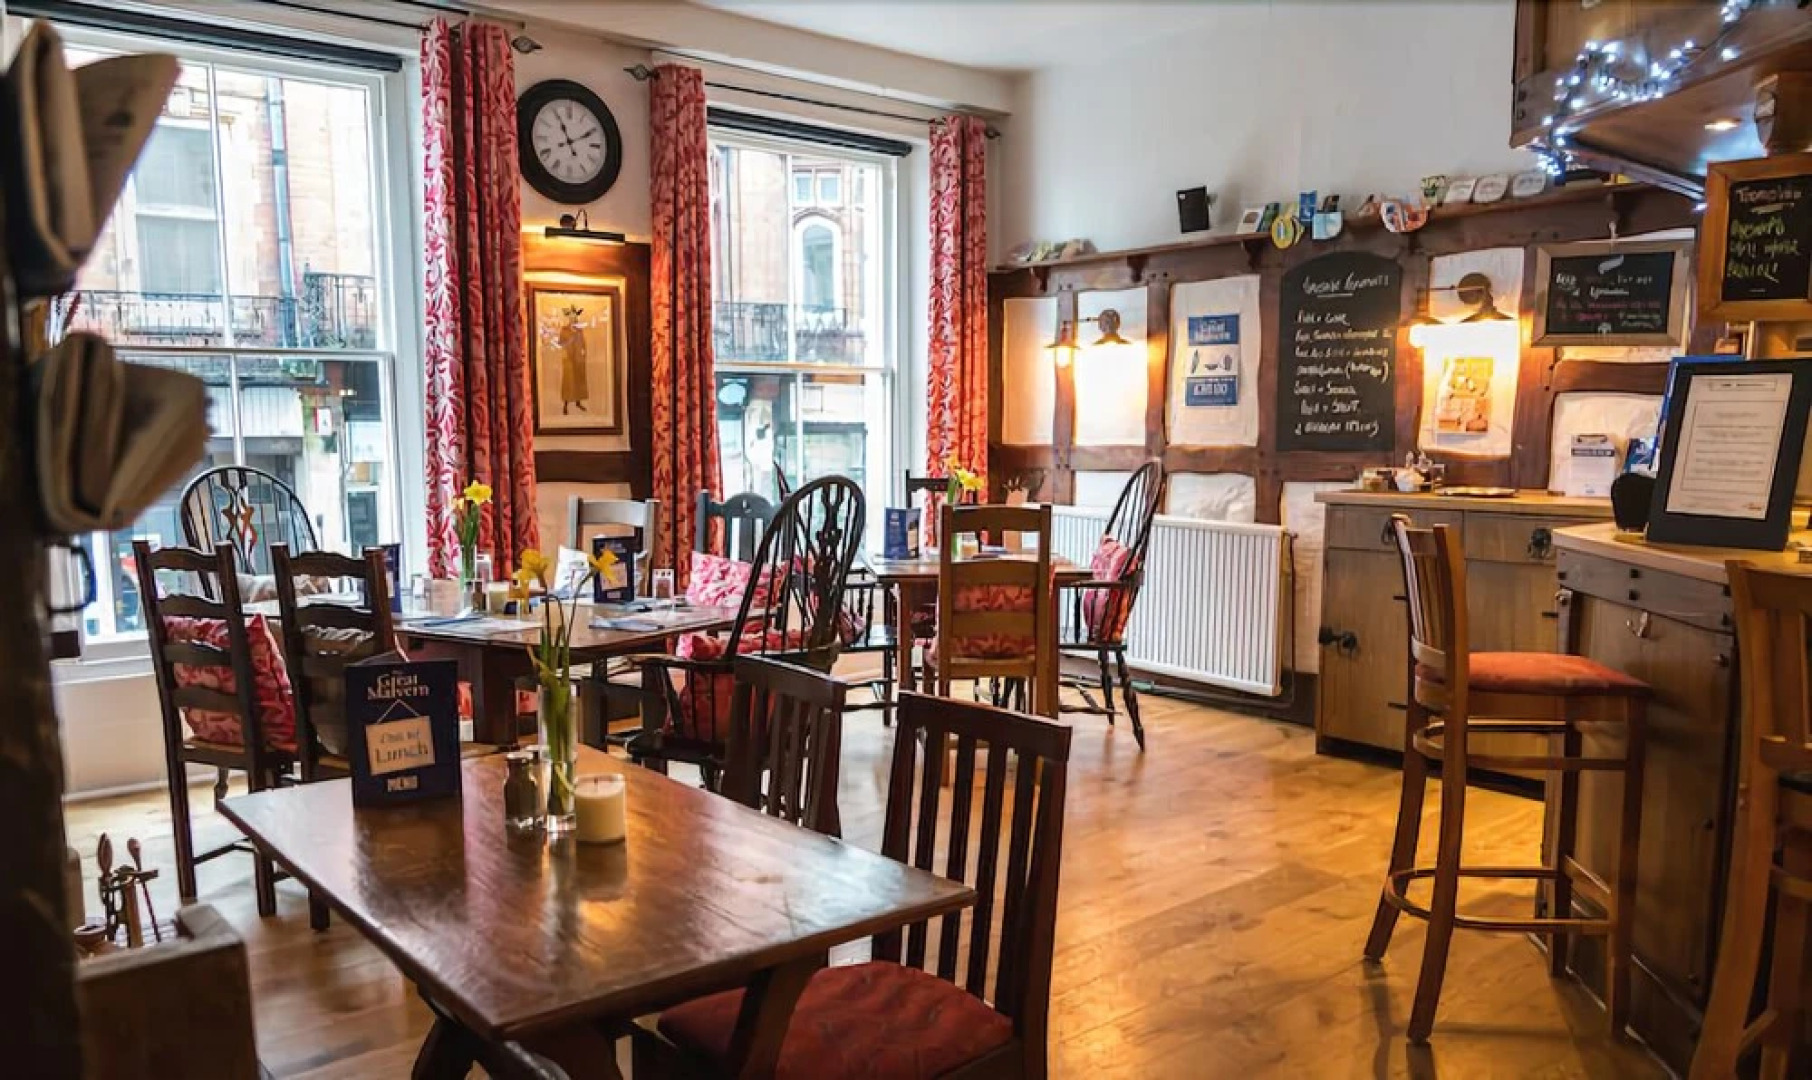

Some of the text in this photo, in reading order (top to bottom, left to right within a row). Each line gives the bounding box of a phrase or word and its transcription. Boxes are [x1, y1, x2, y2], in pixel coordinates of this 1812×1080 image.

[377, 673, 418, 690] Great
[367, 684, 430, 699] Malvern
[376, 741, 428, 763] Lunch
